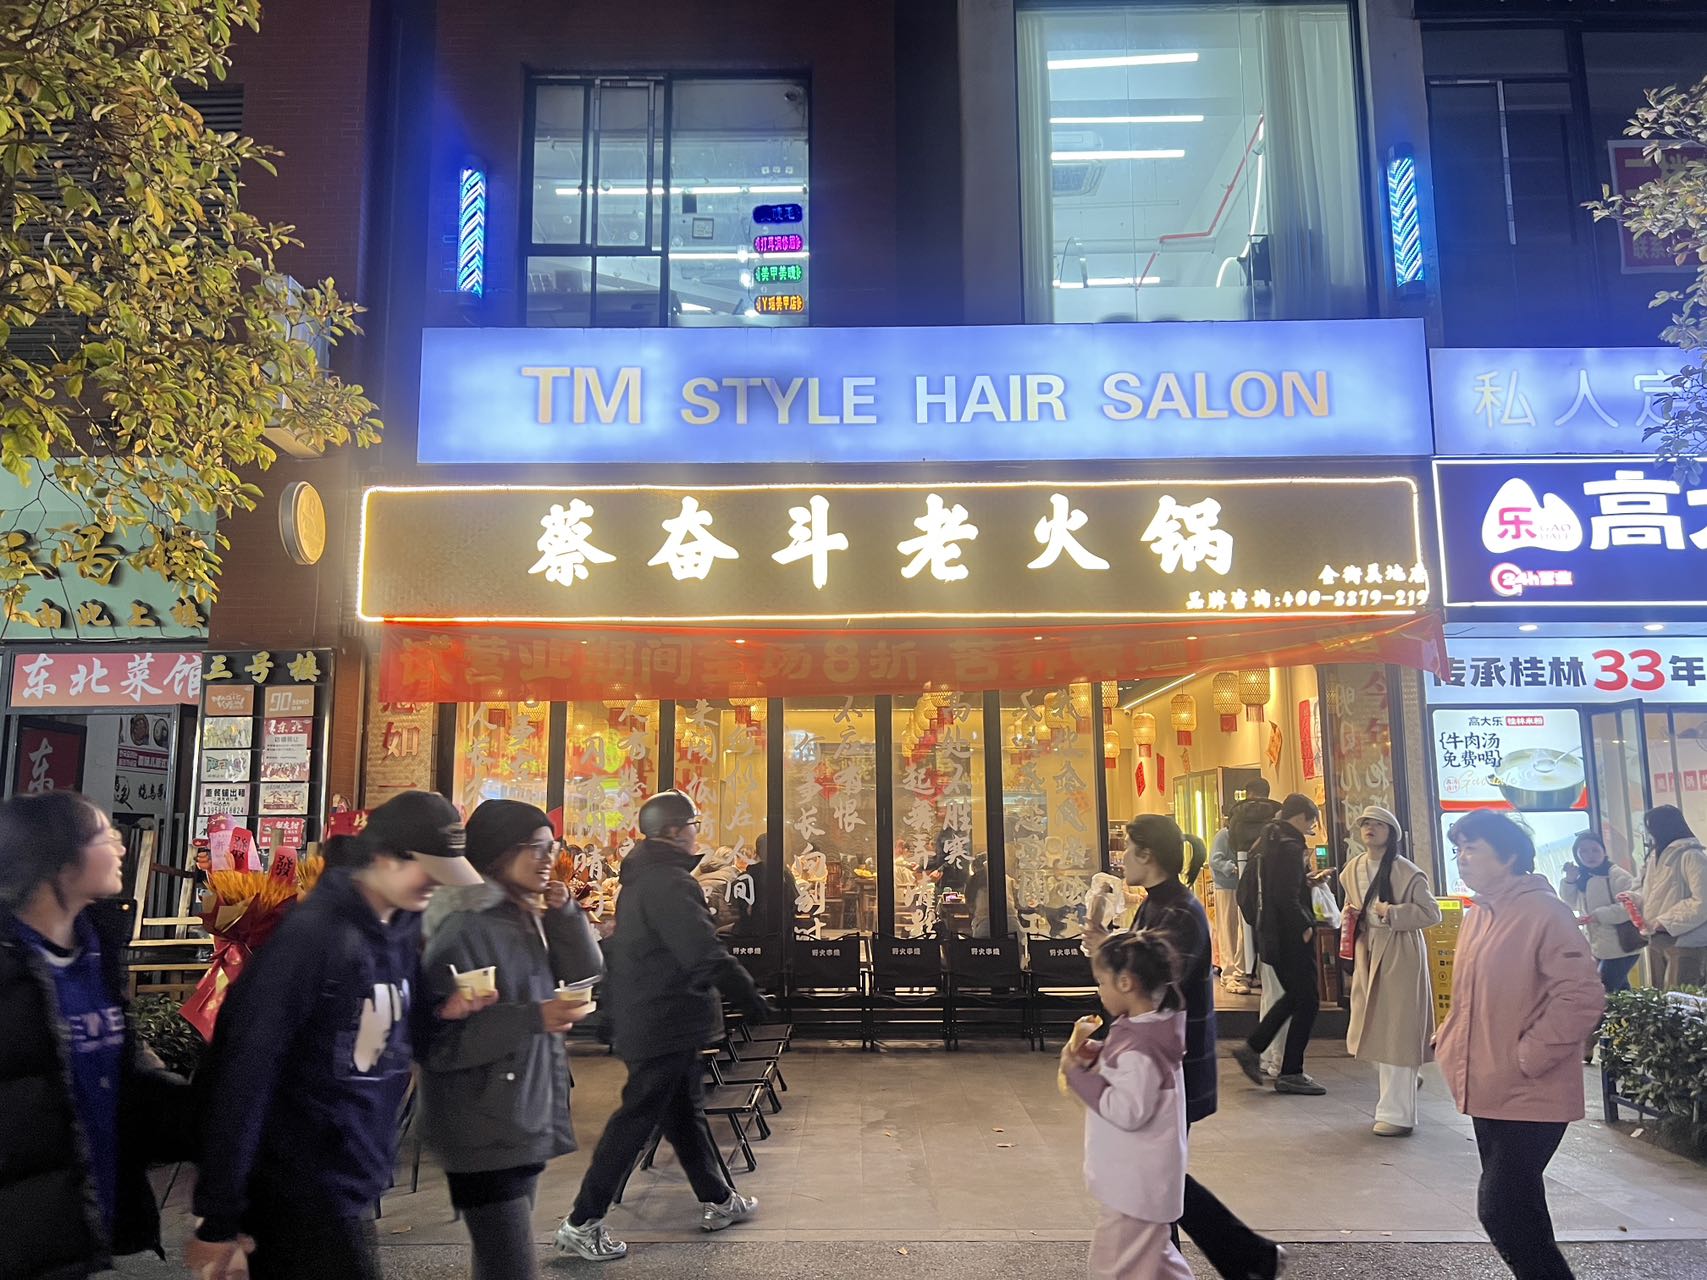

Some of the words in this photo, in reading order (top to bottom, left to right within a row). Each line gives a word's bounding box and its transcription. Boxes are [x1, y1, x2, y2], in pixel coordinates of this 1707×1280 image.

[521, 367, 641, 424] TM
[681, 376, 878, 425] STYLE
[915, 374, 1066, 424] HAIR
[1103, 370, 1330, 420] SALON
[527, 493, 1234, 589] 蔡奋斗老火锅
[1497, 507, 1537, 540] 乐
[21, 652, 201, 702] 东北菜馆
[203, 650, 320, 683] 三号楼
[1468, 716, 1504, 727] 高大乐
